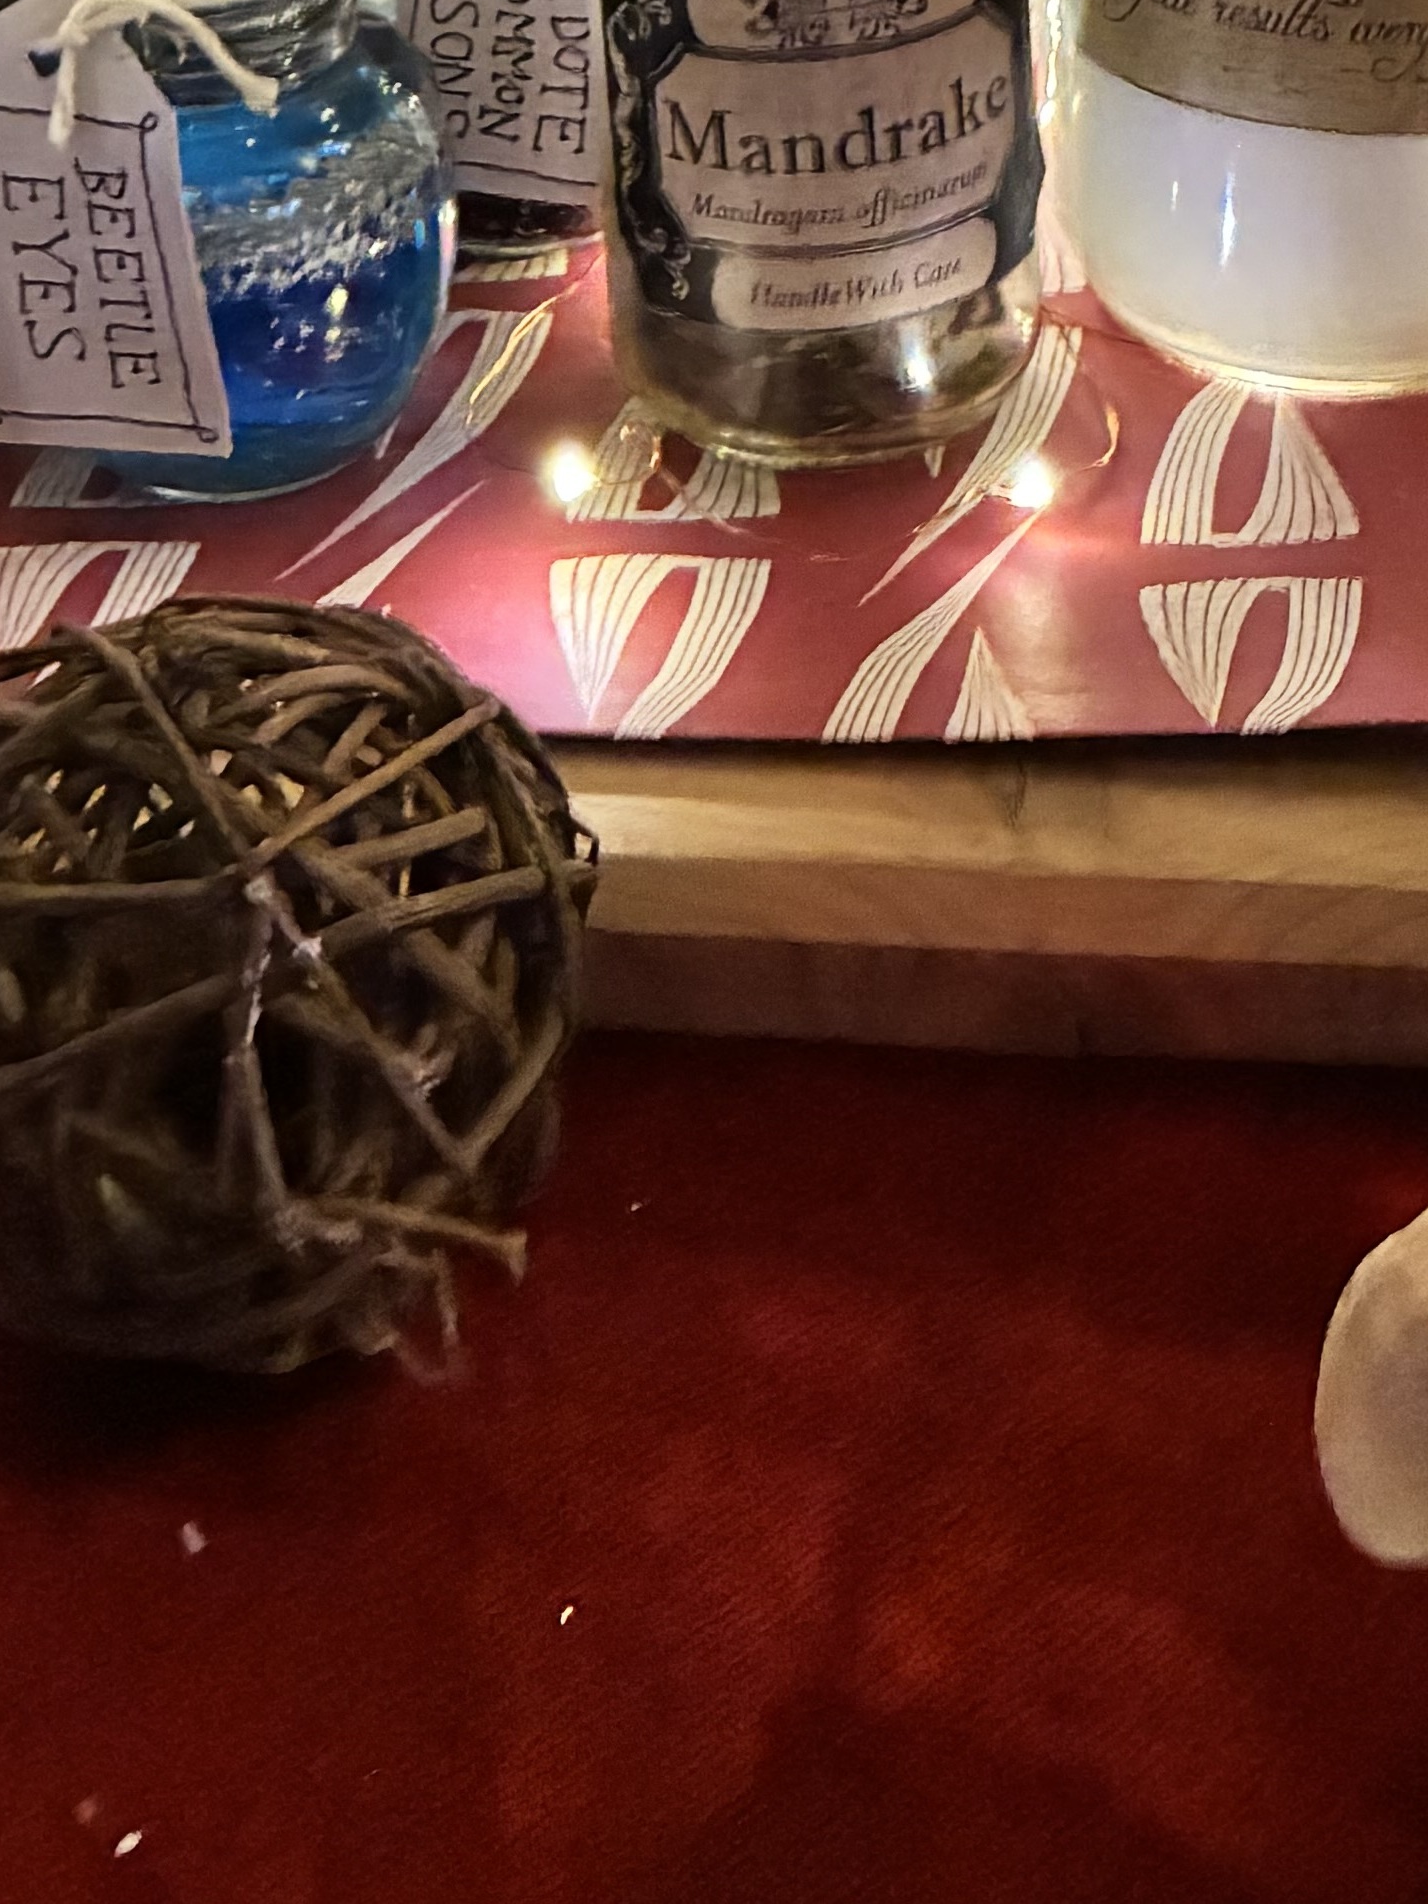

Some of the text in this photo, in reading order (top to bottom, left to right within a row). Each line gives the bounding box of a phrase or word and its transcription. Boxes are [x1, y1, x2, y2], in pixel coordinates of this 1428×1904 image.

[664, 73, 1008, 176] Mandrake
[2, 171, 85, 362] EYES
[74, 157, 160, 389] BEETLE
[751, 257, 962, 309] Handle With Care
